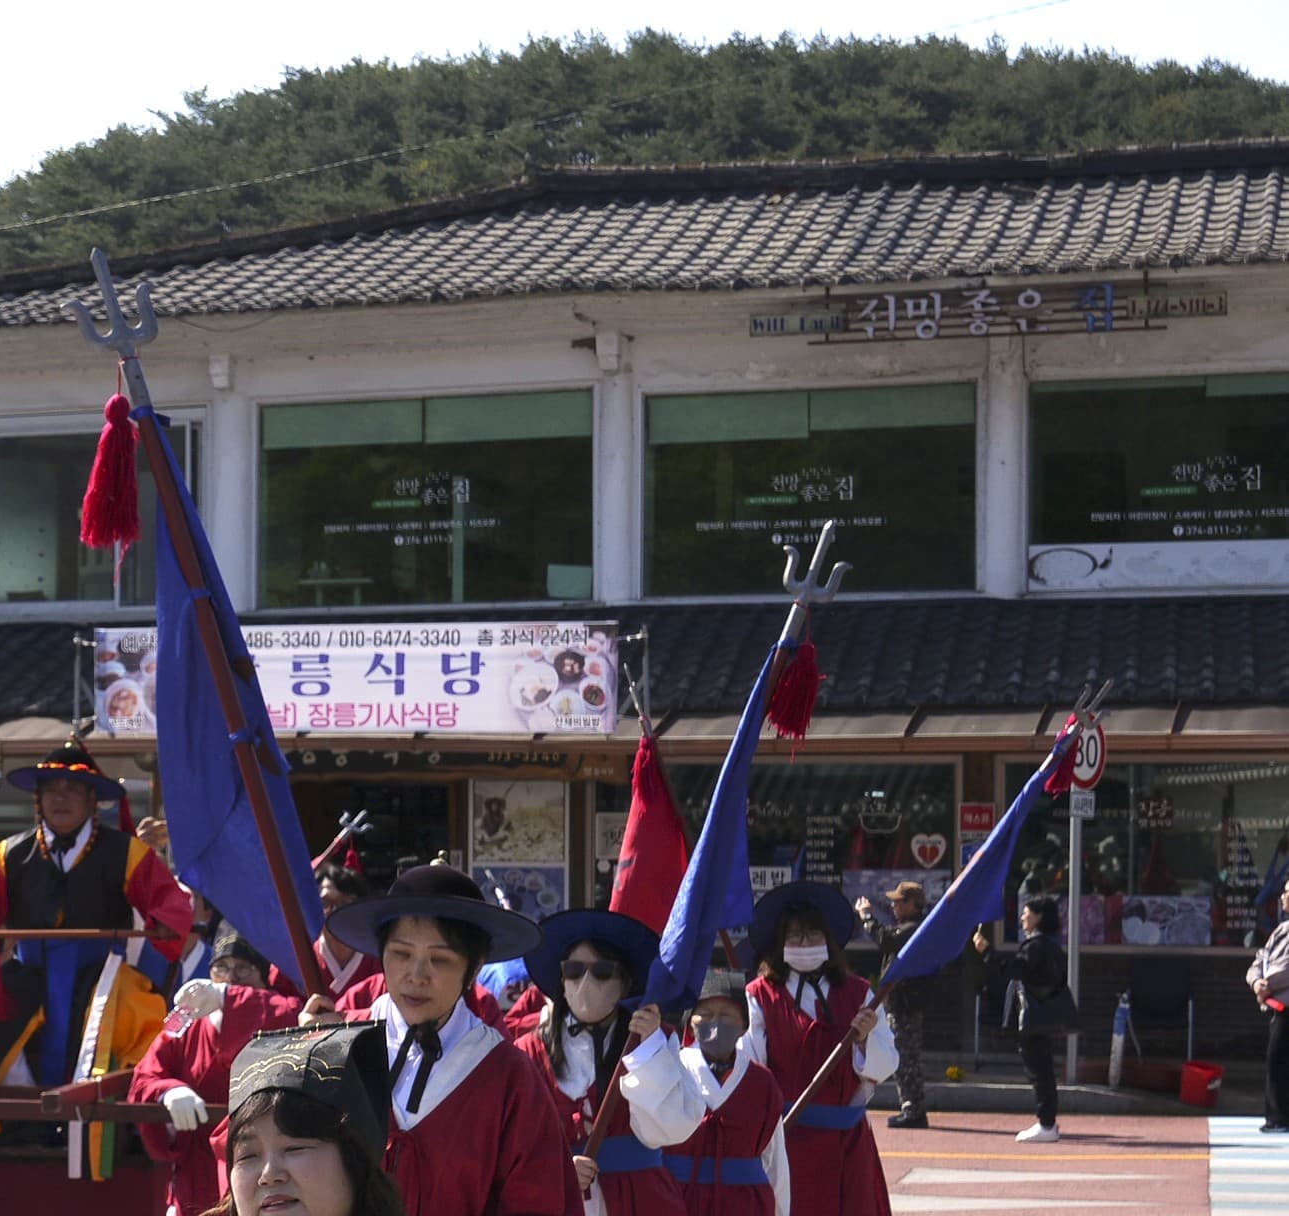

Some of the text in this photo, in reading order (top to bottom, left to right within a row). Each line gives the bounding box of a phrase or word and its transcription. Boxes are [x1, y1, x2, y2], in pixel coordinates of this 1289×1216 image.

[339, 629, 461, 648] 010-6474-3340
[253, 652, 486, 697] 릉식당
[308, 703, 460, 728] 장릉기사식당
